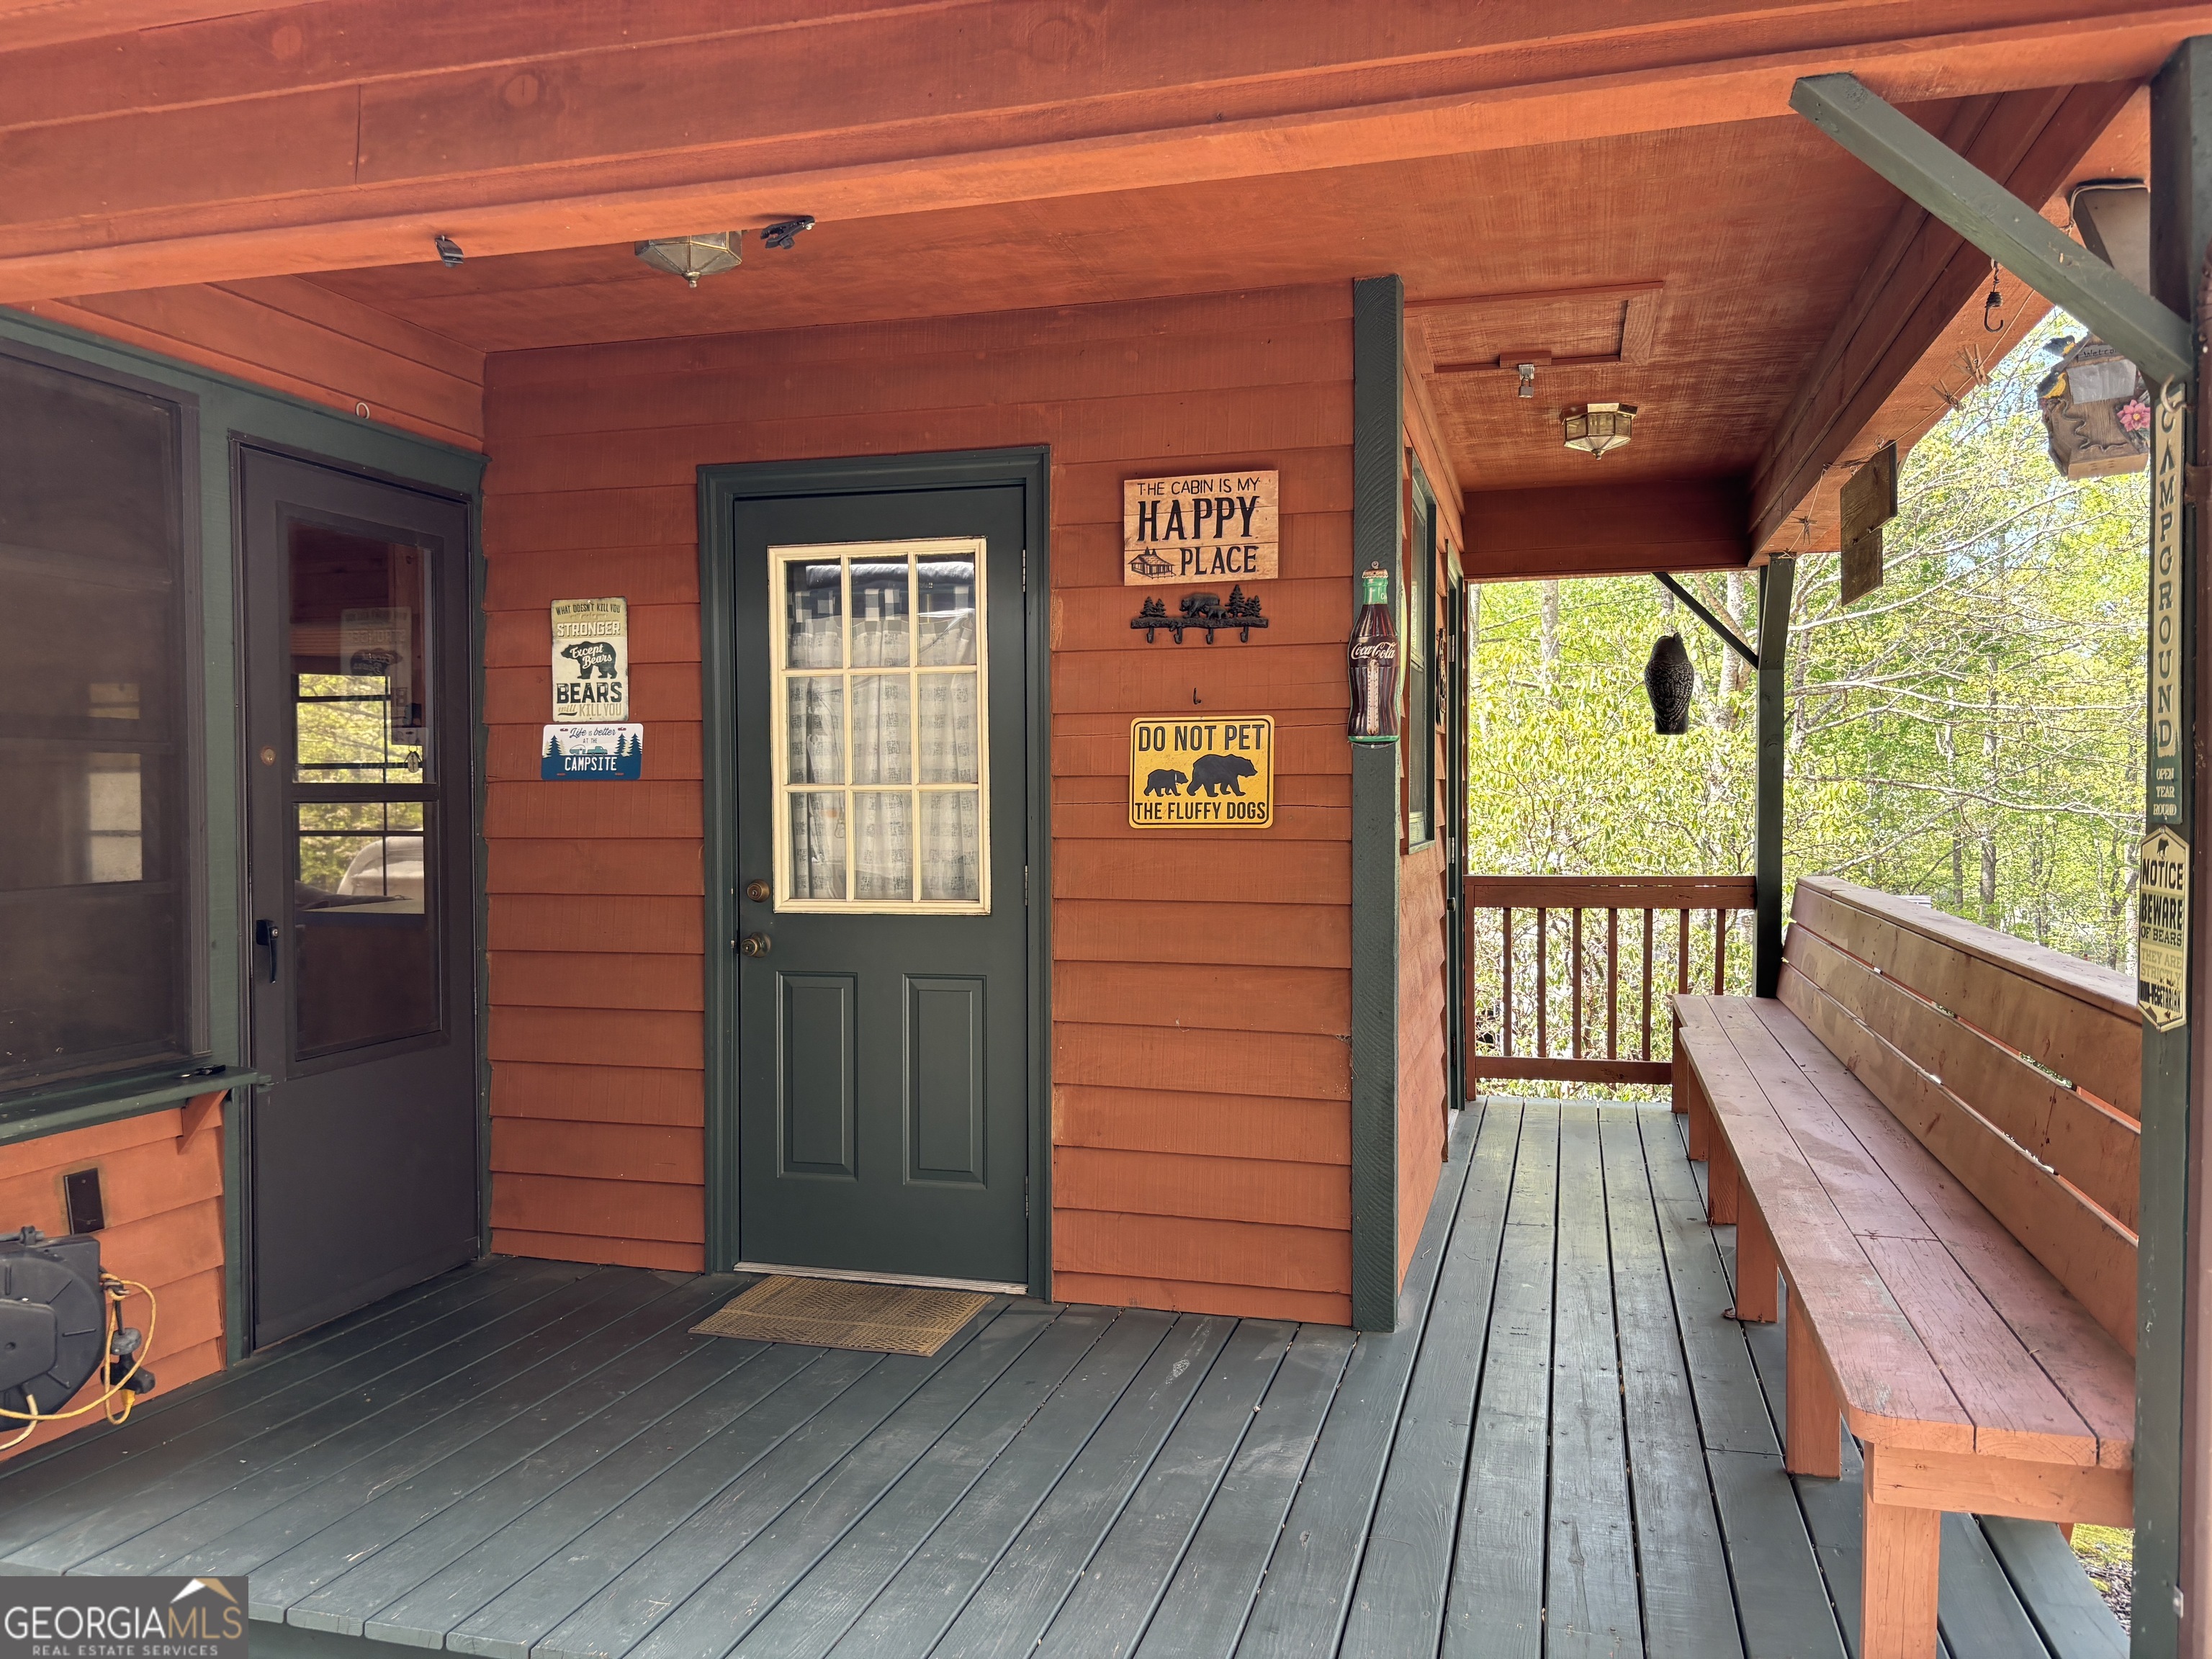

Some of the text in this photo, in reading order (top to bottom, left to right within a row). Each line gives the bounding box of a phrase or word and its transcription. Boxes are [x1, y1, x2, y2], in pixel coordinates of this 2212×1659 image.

[1137, 477, 1259, 495] THE CABIN IS MY
[1137, 495, 1260, 541] HAPPY
[1179, 545, 1259, 576] PLACE
[2158, 400, 2176, 747] CAMPGROUND
[556, 603, 621, 616] WHAT DOESN'T KILL YOU
[557, 621, 621, 637] STRONGER
[570, 644, 603, 659] Except
[583, 653, 612, 670] Bears
[557, 681, 622, 703] BEARS
[579, 703, 602, 716] KILL
[603, 703, 622, 716] YOU
[570, 727, 587, 739] Life
[593, 727, 616, 737] better
[1138, 724, 1265, 751] DO NOT PET
[565, 757, 617, 771] CAMPSITE
[2156, 768, 2175, 781] OPEN
[2156, 786, 2175, 798] YEAR
[1135, 801, 1266, 819] THE FLUFFY DOGS
[2153, 804, 2177, 816] ROUND
[2142, 858, 2184, 891] NOTICE
[2141, 893, 2183, 931] BEWARE
[2141, 925, 2182, 947] OF BEARS
[2141, 948, 2182, 969] THEY ARE
[2141, 963, 2182, 989] STRICTLY
